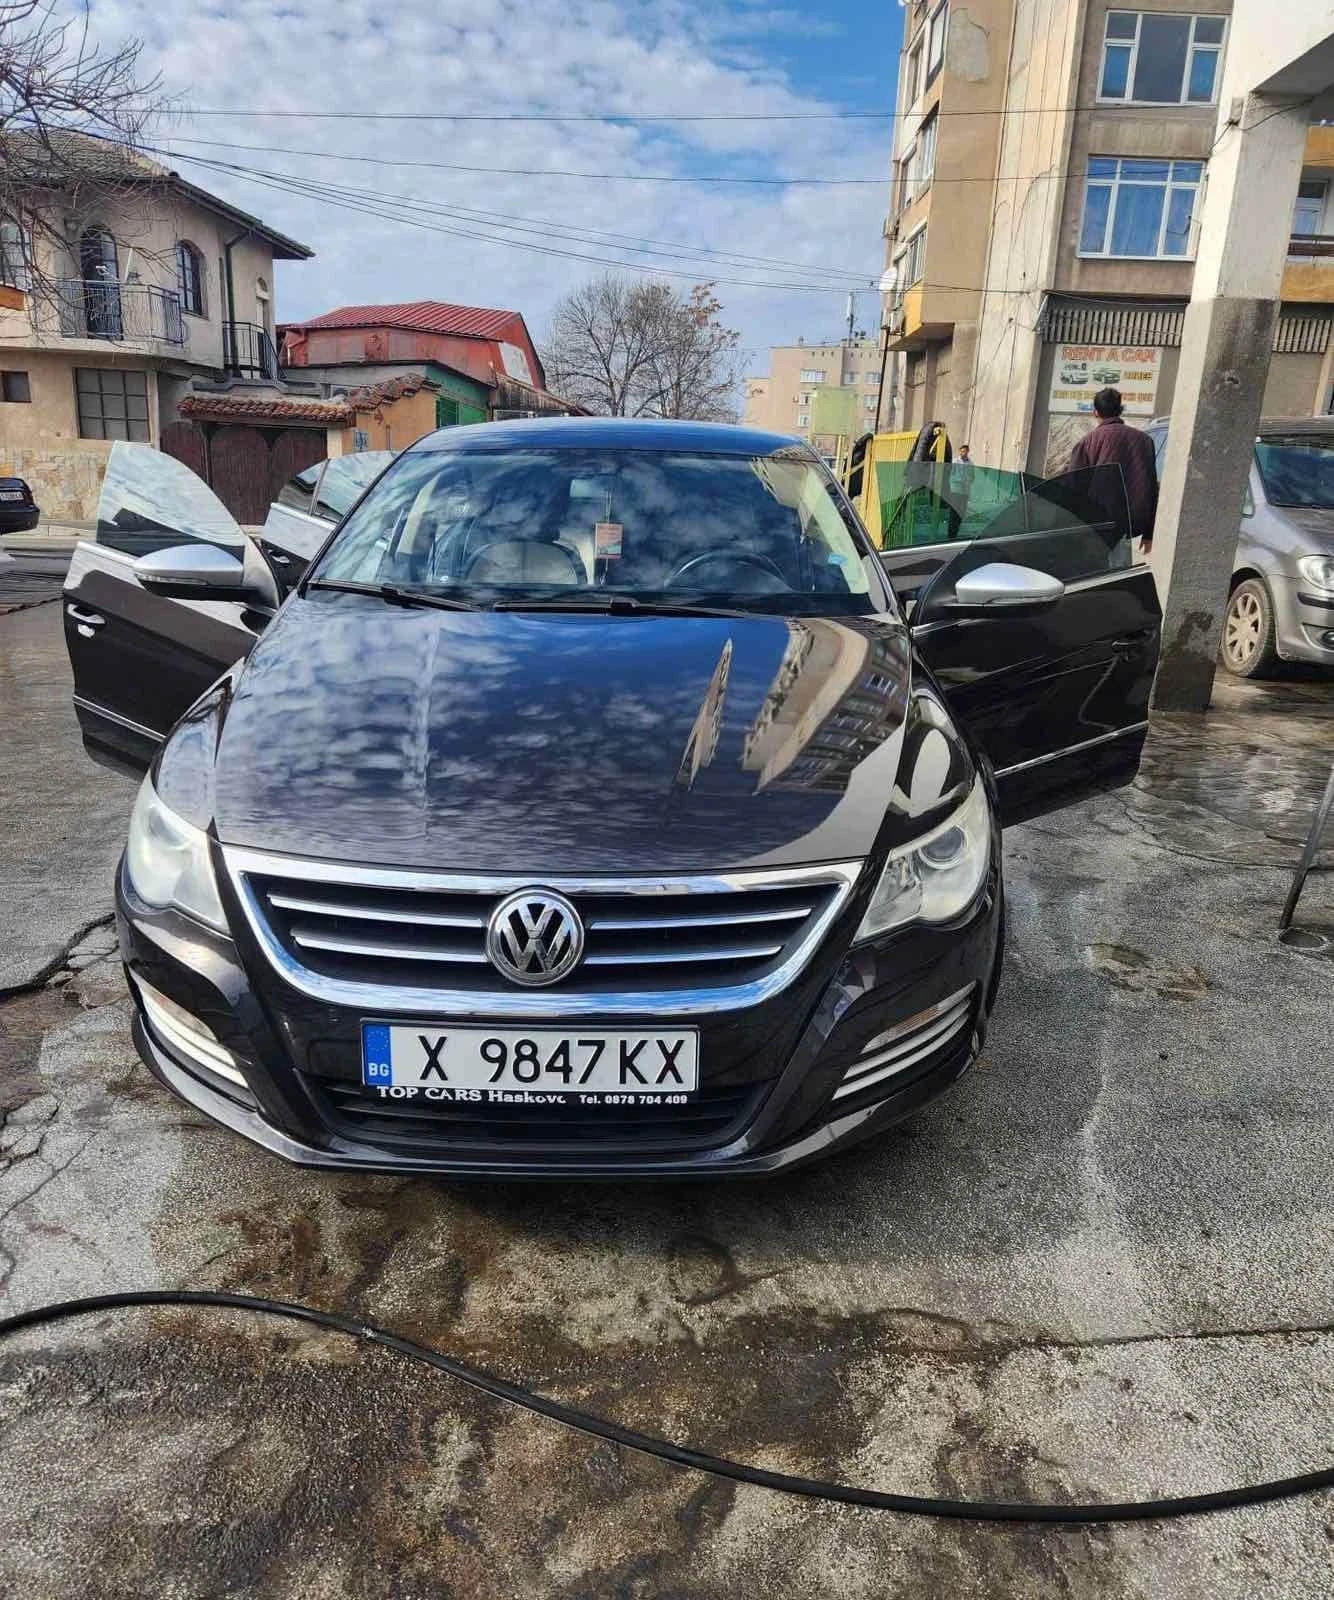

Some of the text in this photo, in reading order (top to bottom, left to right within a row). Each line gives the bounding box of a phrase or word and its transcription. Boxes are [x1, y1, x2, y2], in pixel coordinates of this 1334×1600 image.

[1062, 346, 1155, 363] RENT A CAR
[495, 896, 579, 980] VW
[418, 1035, 685, 1084] X 9847 KX
[368, 1063, 389, 1076] BG
[376, 1086, 419, 1098] TOP
[425, 1088, 482, 1101] CARS
[579, 1094, 601, 1104] Tel.
[604, 1095, 635, 1105] 0878
[639, 1095, 661, 1105] 704
[664, 1095, 688, 1105] 409
